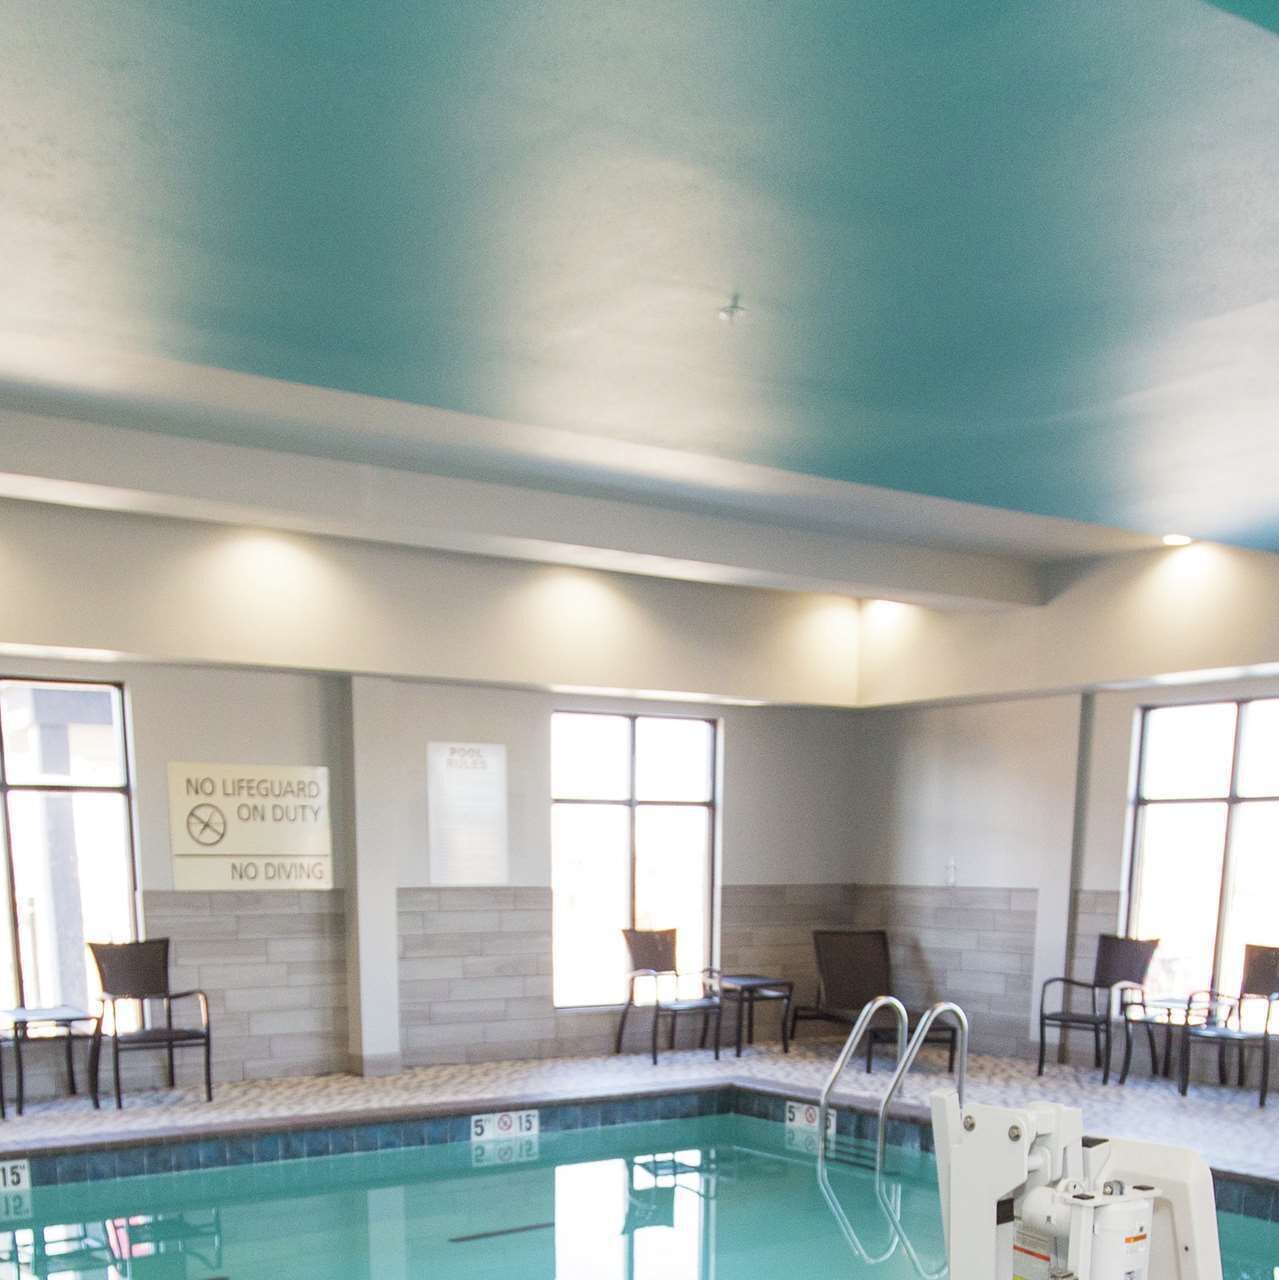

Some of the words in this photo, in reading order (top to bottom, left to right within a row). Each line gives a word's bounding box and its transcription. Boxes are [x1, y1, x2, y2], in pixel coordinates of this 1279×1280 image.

[185, 777, 215, 796] NO
[221, 778, 320, 798] LIFEGUARD
[236, 803, 265, 822] ON
[271, 803, 320, 822] DUTY
[231, 862, 258, 880] NO
[264, 862, 324, 880] DIVING
